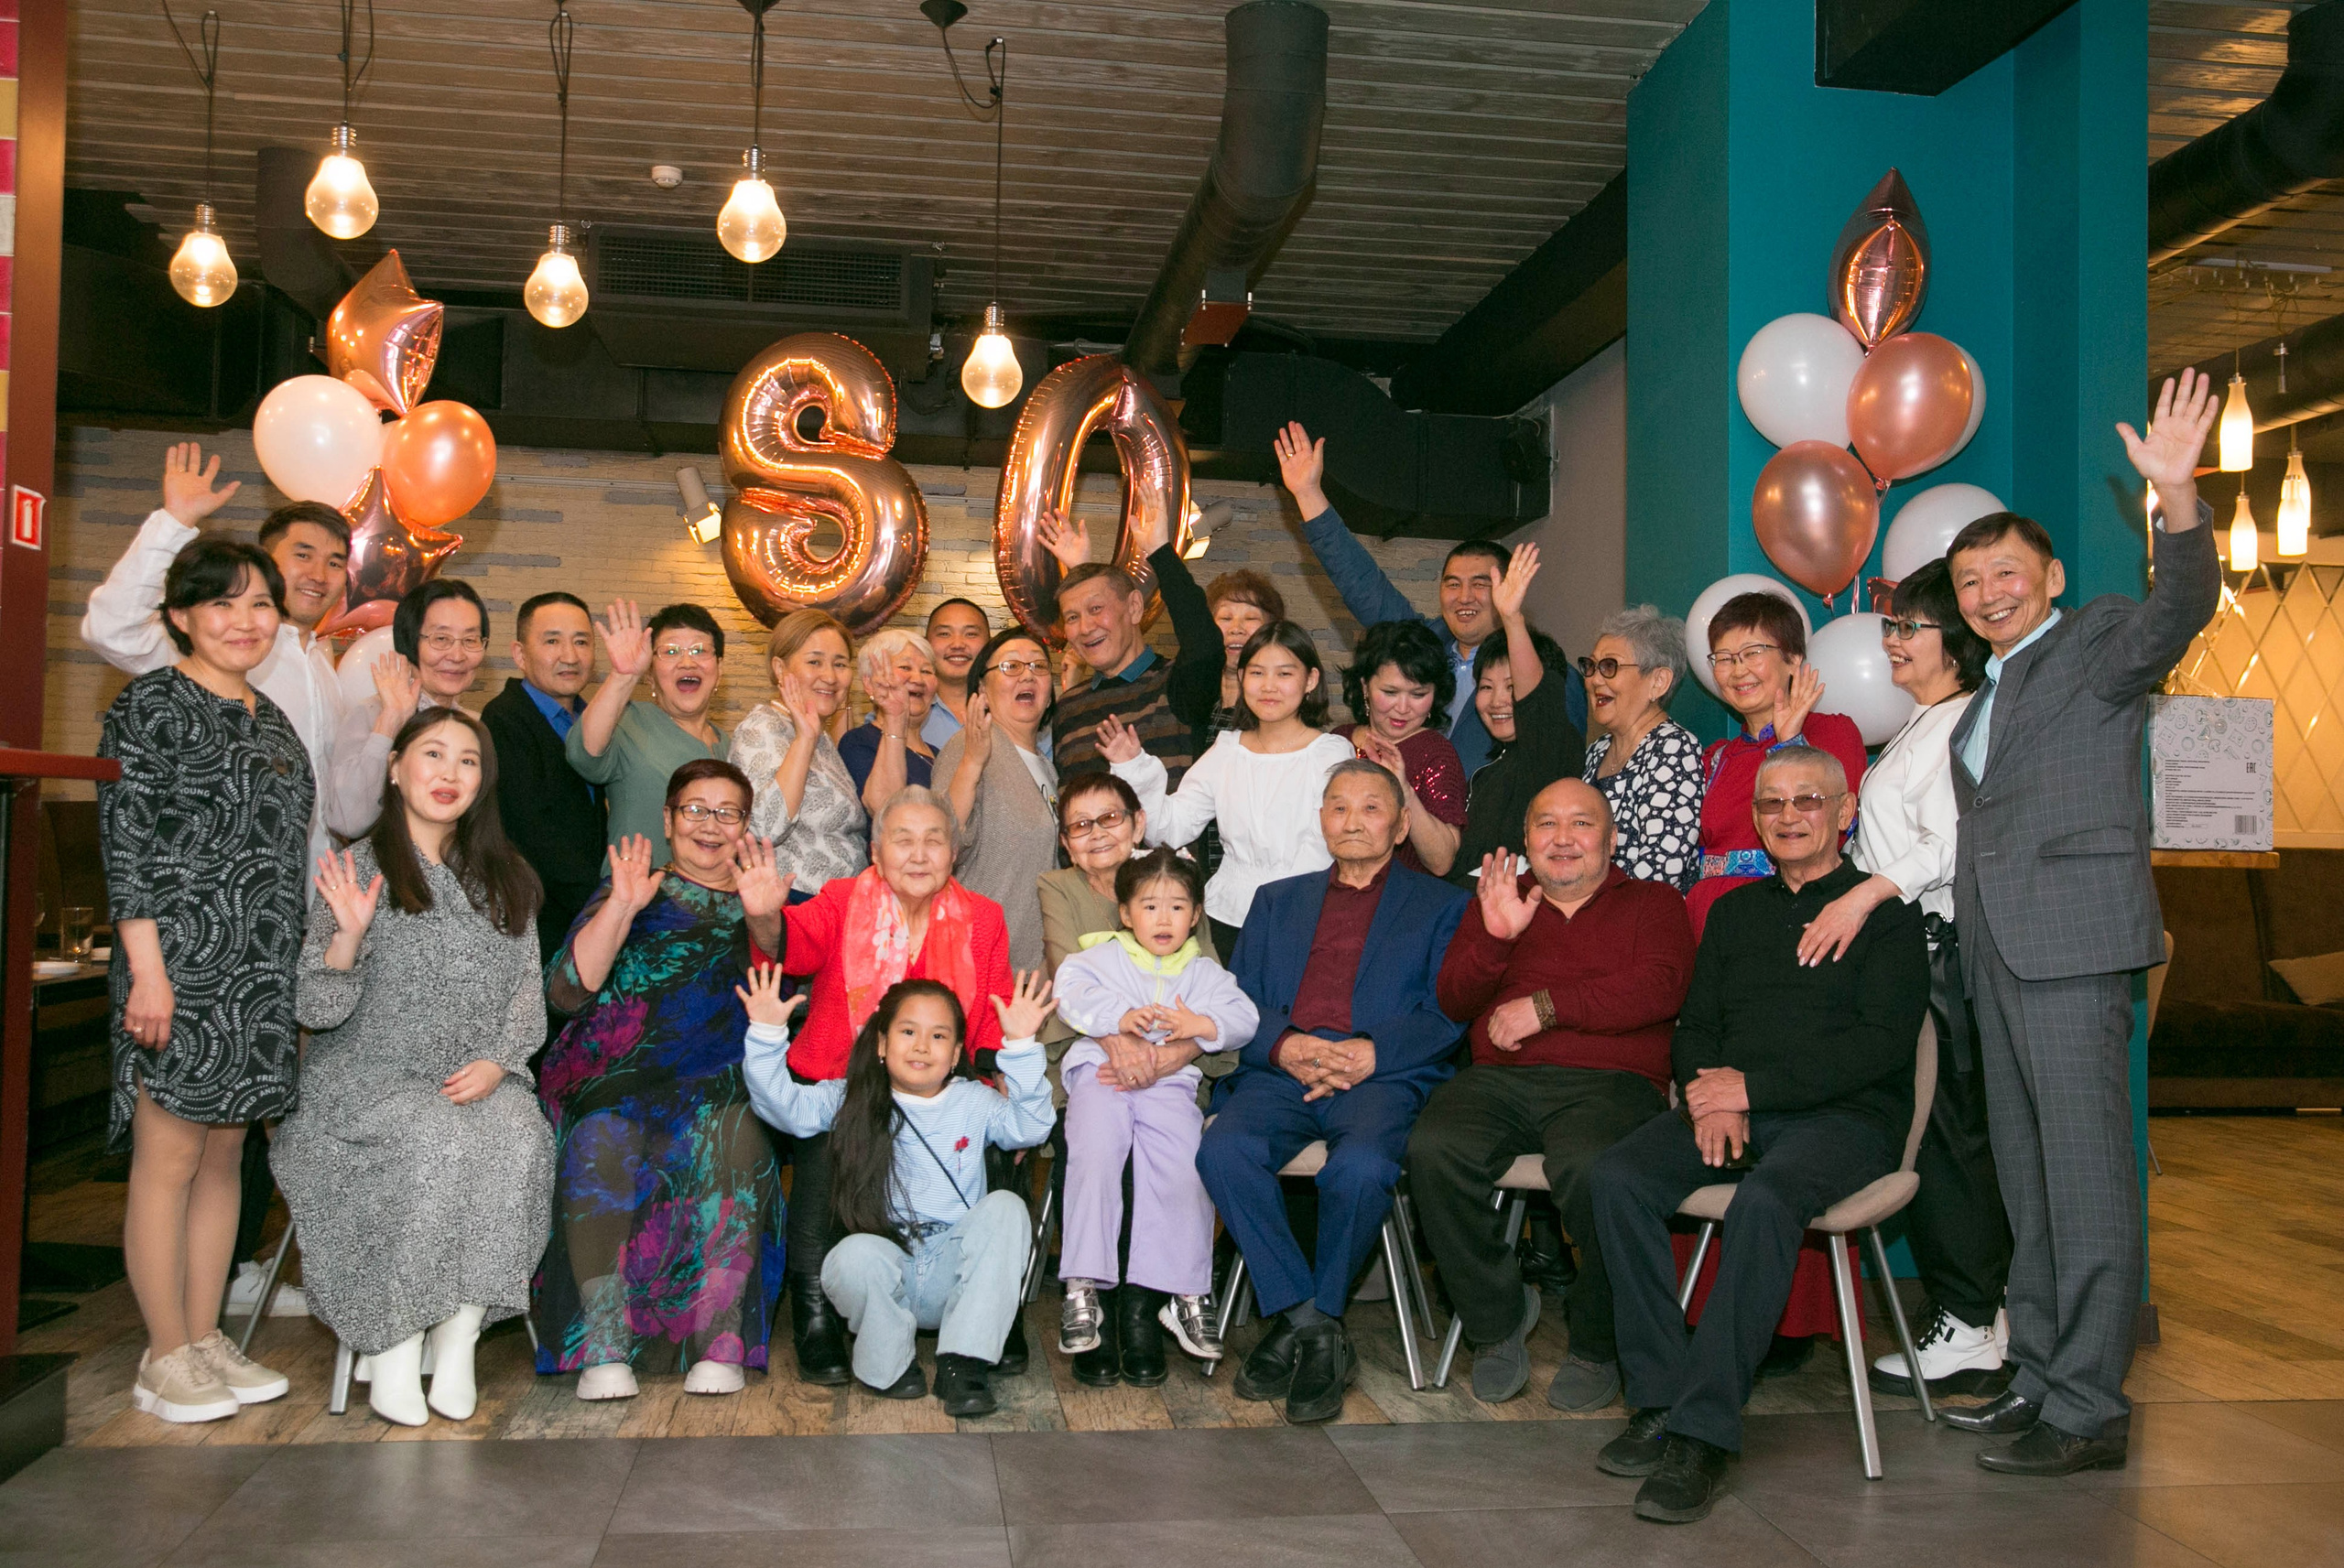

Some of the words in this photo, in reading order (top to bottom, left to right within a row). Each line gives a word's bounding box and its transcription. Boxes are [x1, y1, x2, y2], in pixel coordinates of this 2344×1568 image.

[189, 722, 201, 742] FREE
[2246, 762, 2257, 773] EAC
[179, 787, 210, 797] YOUNG
[216, 795, 232, 810] WILD
[224, 776, 242, 804] YOUNG
[242, 773, 251, 803] YOUNG
[153, 868, 172, 879] AND
[174, 867, 199, 881] FREE
[220, 861, 234, 881] WILD
[235, 849, 253, 862] AND
[239, 868, 256, 885] WILD
[258, 860, 274, 870] AND
[216, 887, 233, 918] YOUNG
[234, 887, 244, 919] YOUNG
[203, 904, 221, 923] WILD
[250, 908, 260, 929] WILD
[260, 908, 283, 922] YOUNG
[283, 919, 292, 939] WILD
[174, 922, 185, 942] WILD
[189, 916, 199, 937] WILD
[211, 924, 220, 942] AND
[234, 919, 245, 950] YOUNG
[183, 938, 196, 956] AND
[194, 943, 214, 963] FREE
[250, 933, 271, 959] YOUNG
[221, 952, 239, 970] WILD
[200, 968, 218, 980] AND
[217, 976, 233, 997] WILD
[233, 964, 251, 977] AND
[255, 961, 276, 970] FREE
[236, 981, 255, 1000] WILD
[256, 973, 273, 984] AND
[182, 997, 218, 1007] YOUNG
[215, 1002, 233, 1033] YOUNG
[233, 1002, 244, 1033] YOUNG
[249, 1022, 259, 1043] WILD
[255, 1006, 269, 1022] AND
[260, 1021, 286, 1034] YOUNG
[202, 1020, 219, 1038] WILD
[173, 1038, 185, 1058] WILD
[188, 1033, 198, 1053] WILD
[210, 1039, 220, 1056] AND
[234, 1033, 245, 1064] YOUNG
[194, 1057, 214, 1078] FREE
[250, 1046, 274, 1073] YOUNG
[125, 1065, 134, 1083] AND
[222, 1066, 239, 1086] WILD
[158, 1092, 183, 1108] FREE
[200, 1083, 219, 1096] AND
[220, 1091, 234, 1111] WILD
[234, 1077, 252, 1090] AND
[256, 1075, 278, 1084] FREE
[240, 1096, 257, 1114] WILD
[260, 1086, 277, 1098] AND
[115, 1092, 132, 1120] YOUNG
